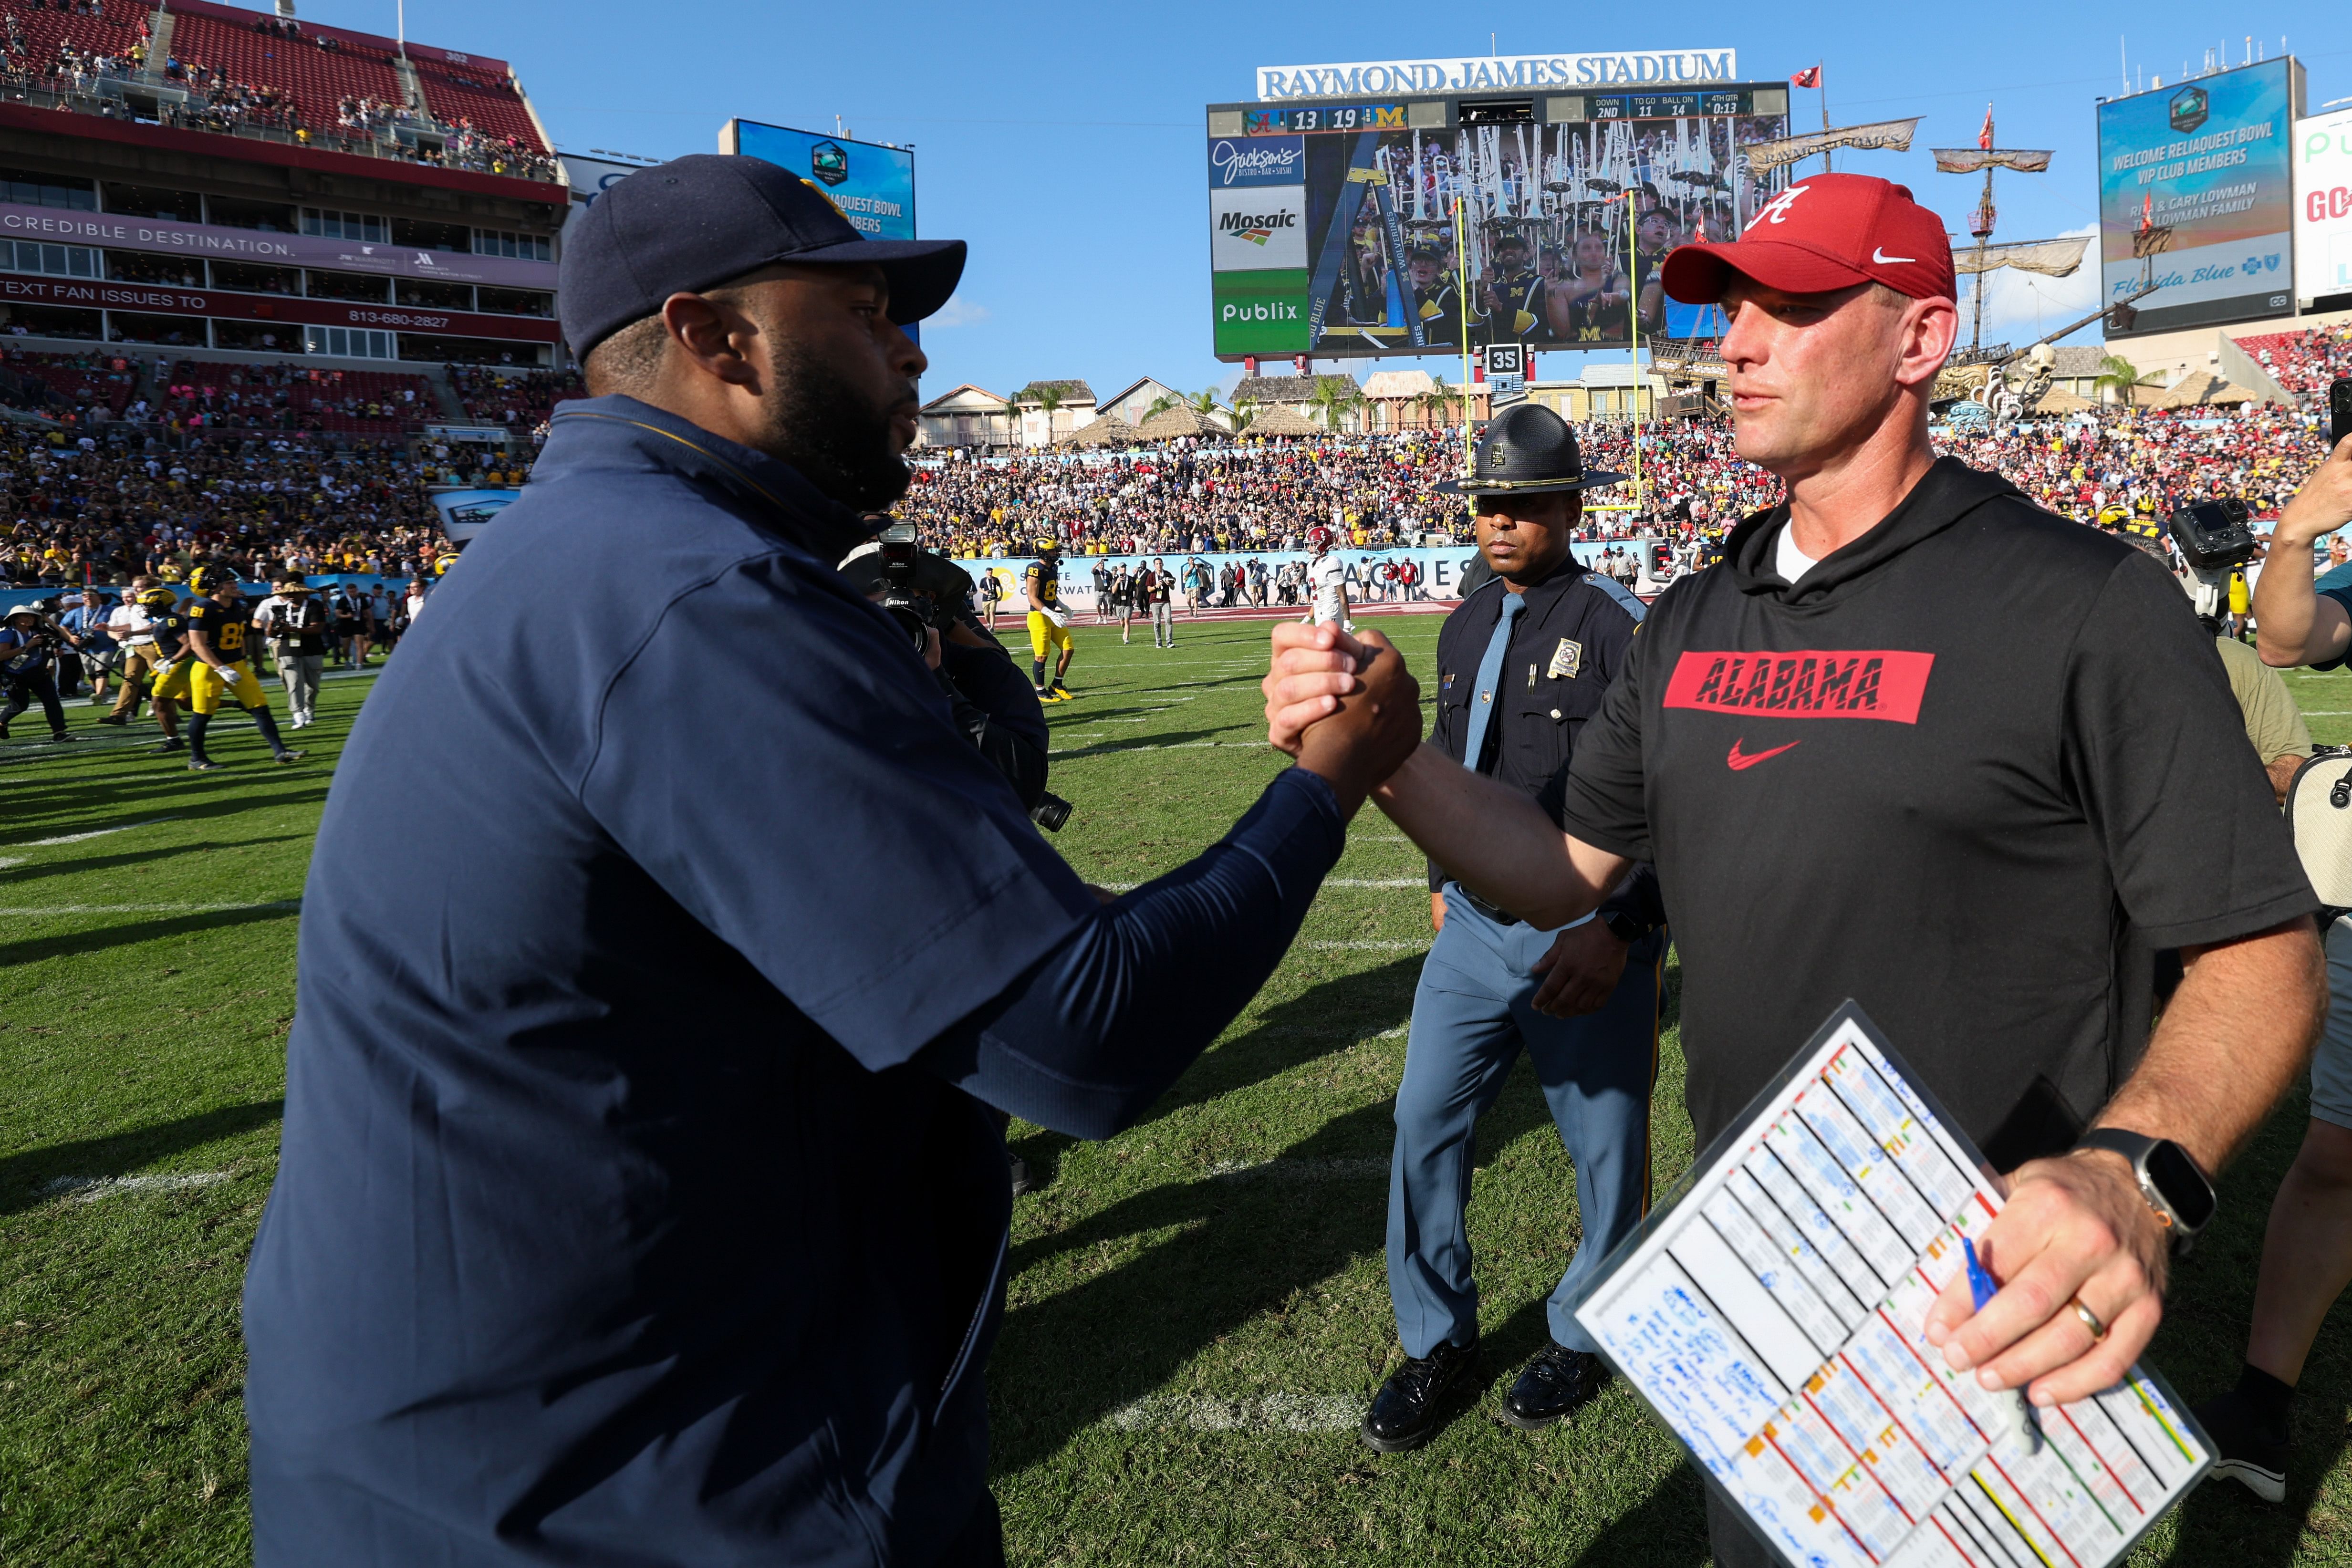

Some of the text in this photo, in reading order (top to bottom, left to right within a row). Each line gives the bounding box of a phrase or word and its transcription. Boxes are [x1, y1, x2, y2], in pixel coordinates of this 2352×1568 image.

[1263, 52, 1732, 97] RAYMOND JAMES STADIUM
[1333, 109, 1356, 128] 19
[1375, 106, 1405, 128] M
[1598, 107, 1618, 118] 2ND
[1639, 105, 1652, 117] 11
[1672, 104, 1685, 115] 14
[1713, 102, 1737, 114] 0:13
[1295, 111, 1317, 130] 13
[2114, 121, 2273, 170] WELCOME RELIAQUEST BOWL
[1212, 140, 1301, 185] Jackson's
[2138, 148, 2247, 185] VIP CLUB MEMBERS
[2157, 201, 2166, 212] &
[2171, 193, 2201, 209] GARY
[2202, 182, 2258, 204] LOWMAN
[874, 200, 902, 218] BOWL
[1744, 185, 1810, 231] A
[2156, 208, 2209, 227] LOWMAN
[2211, 197, 2256, 217] FAMILY
[848, 218, 881, 233] MBERS
[1219, 208, 1296, 230] Mosaic
[4, 215, 296, 257] CREDIBLE DESTINATION.
[1386, 211, 1406, 269] WOLVERINES
[2190, 264, 2235, 284] Blue
[54, 285, 94, 301] FAN
[102, 289, 174, 307] ISSUES
[178, 296, 206, 309] TO
[349, 310, 449, 328] 813-680-2827
[1223, 301, 1298, 322] Publix
[1310, 297, 1326, 324] BLUE
[1493, 351, 1515, 368] 35
[2129, 519, 2157, 527] SPRAGUE
[1320, 530, 1326, 539] 2
[1028, 567, 1039, 577] 83
[1695, 657, 1884, 711] ALABAMA
